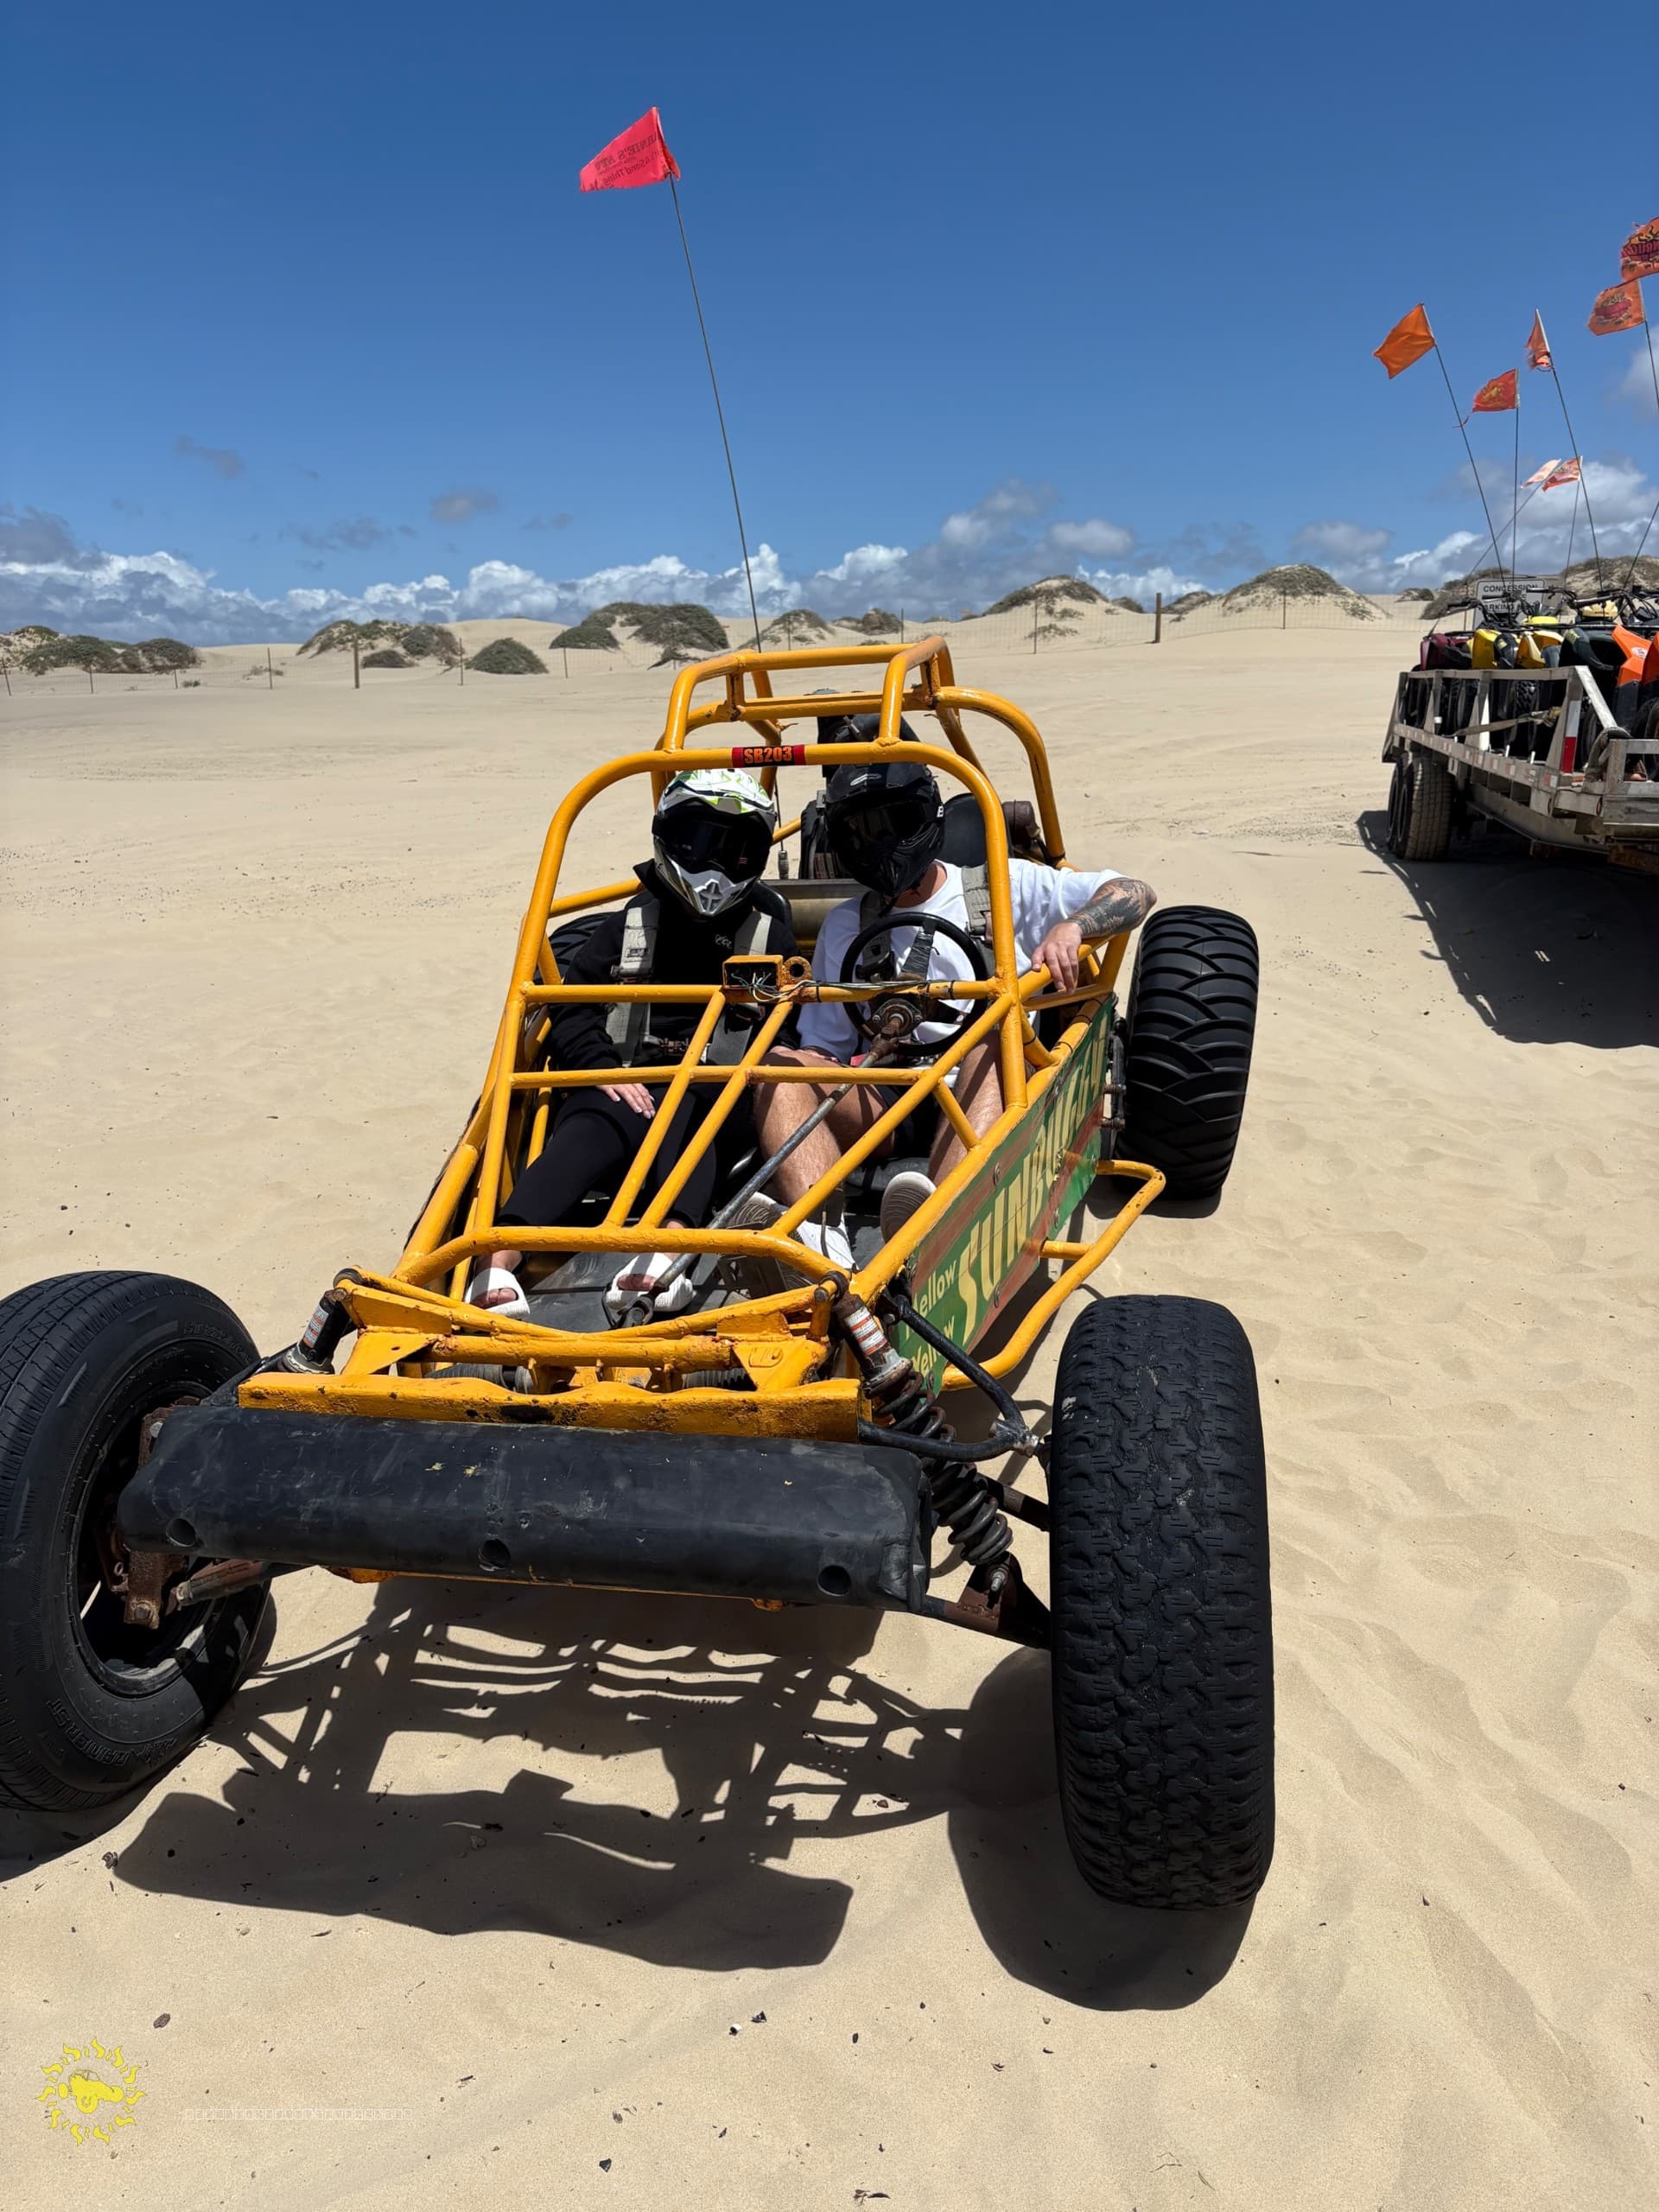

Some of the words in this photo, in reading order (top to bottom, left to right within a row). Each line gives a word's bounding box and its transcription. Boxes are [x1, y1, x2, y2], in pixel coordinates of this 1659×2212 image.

[744, 746, 792, 764] SB203
[958, 1014, 1108, 1346] SUNBUGGY
[912, 1315, 955, 1377] Yellw
